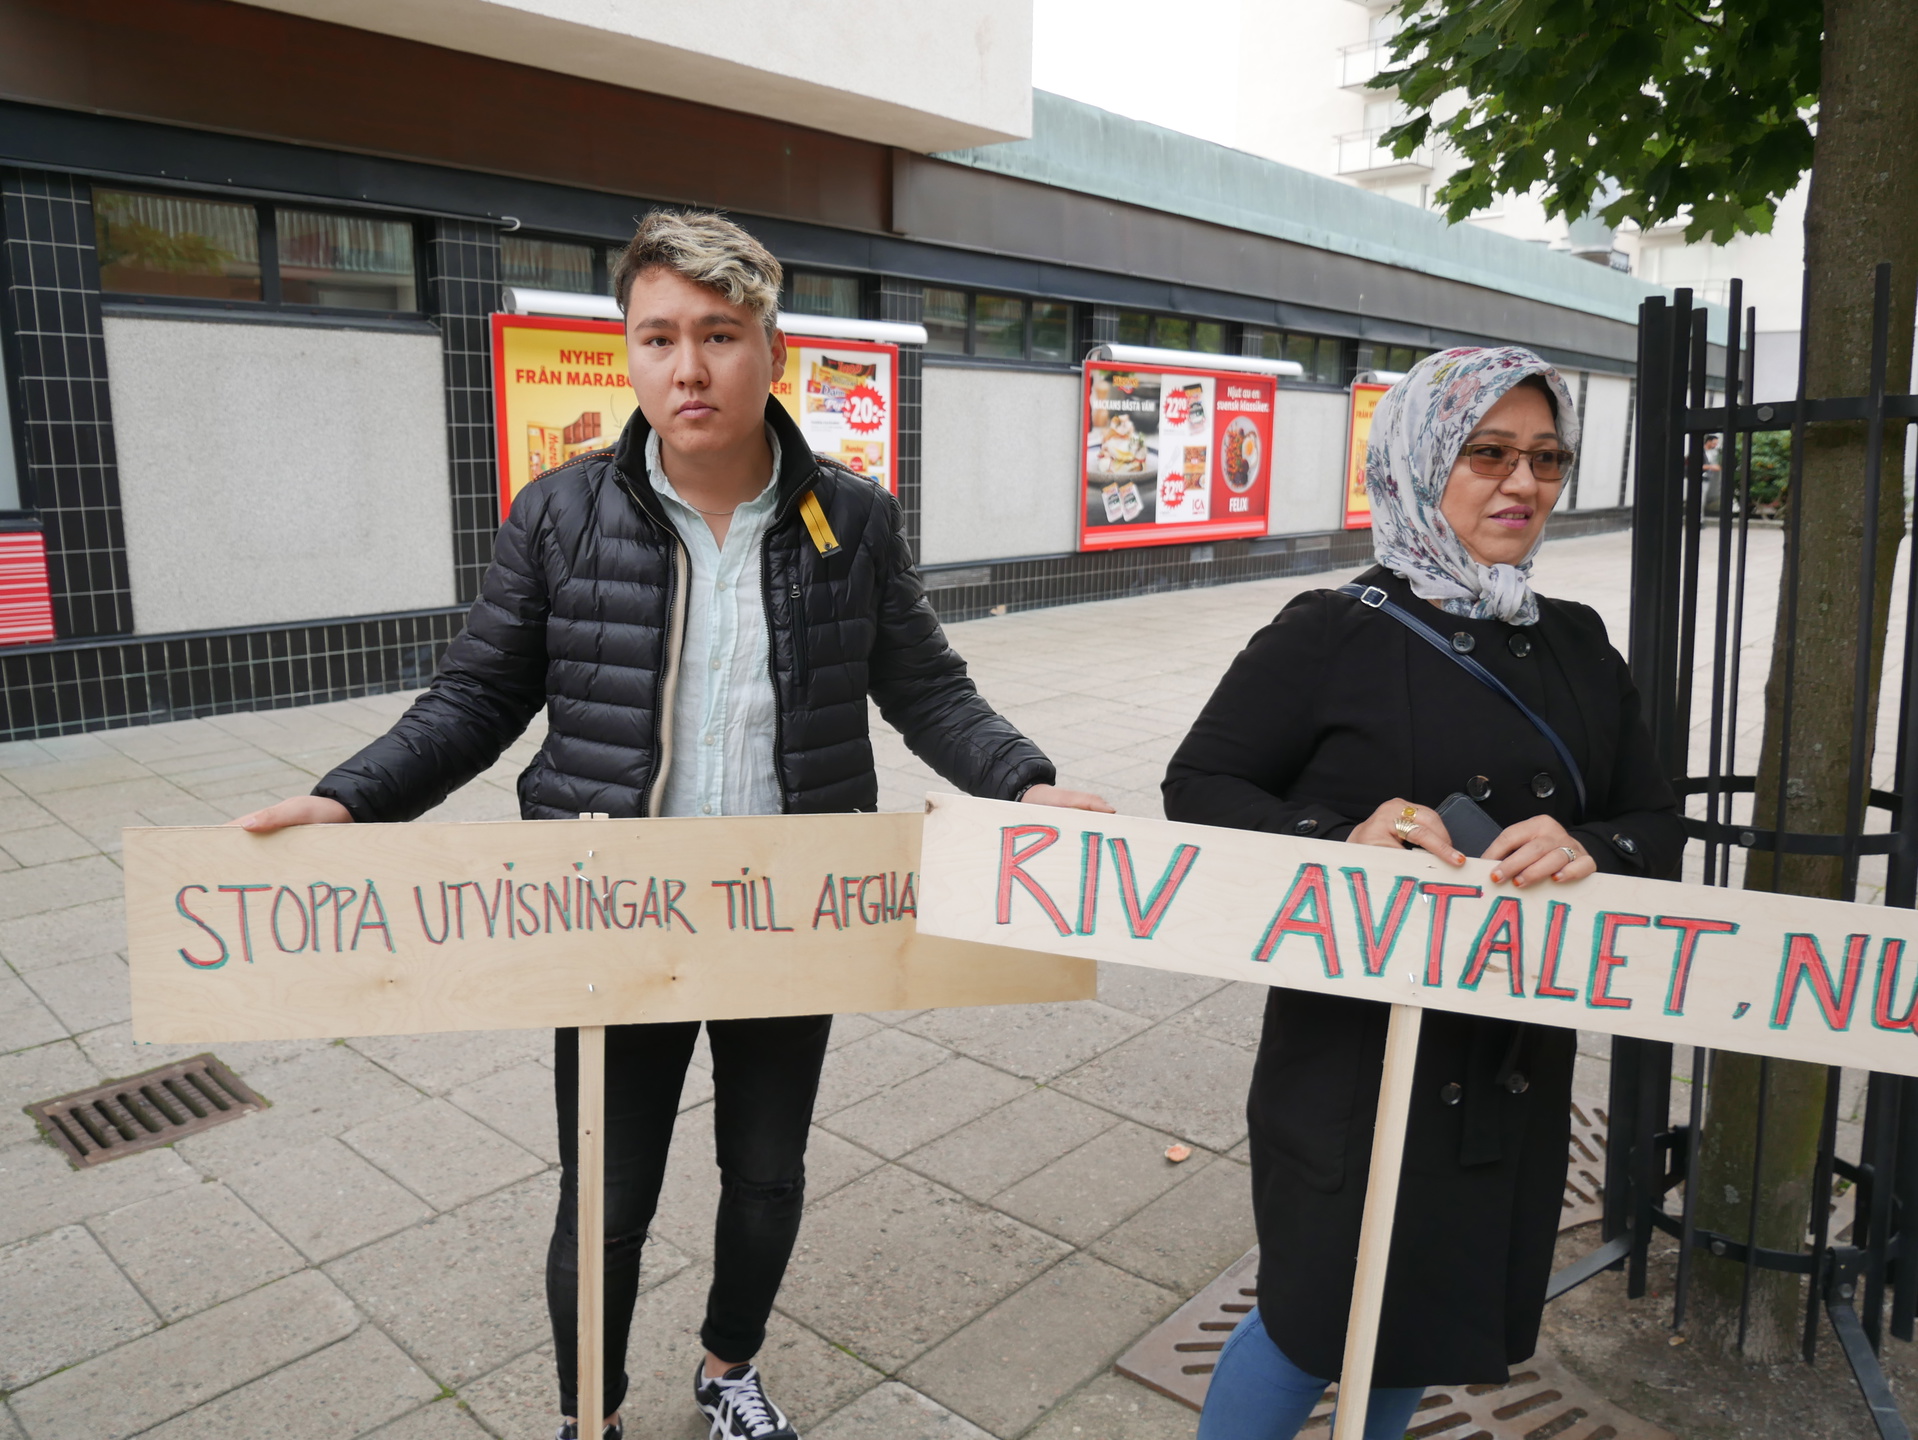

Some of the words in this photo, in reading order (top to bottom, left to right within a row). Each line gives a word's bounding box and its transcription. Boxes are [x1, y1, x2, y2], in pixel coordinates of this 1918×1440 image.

[560, 349, 614, 366] NYHET
[516, 366, 562, 385] FRÅN
[1192, 498, 1205, 511] ICA
[1229, 497, 1249, 512] FELIX
[996, 824, 1200, 939] RIV
[175, 879, 396, 970] STOPPA
[413, 861, 698, 945] UTVISNINGAR
